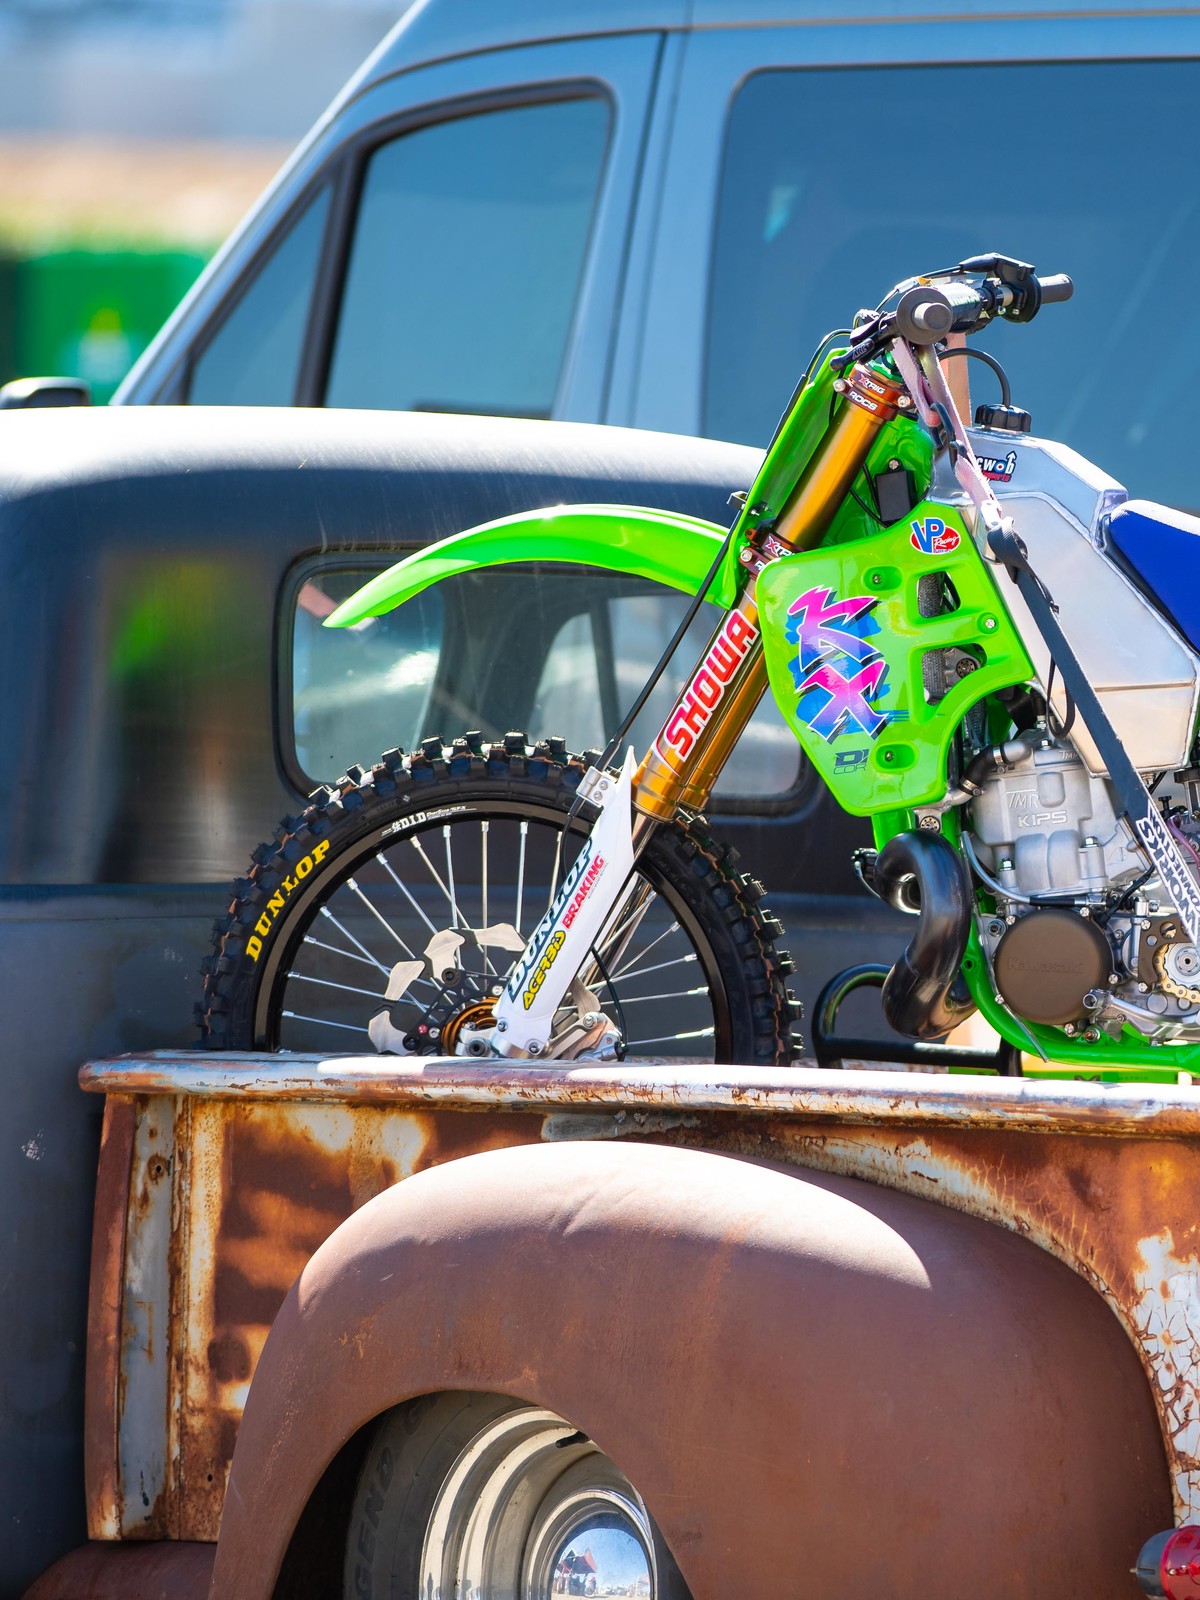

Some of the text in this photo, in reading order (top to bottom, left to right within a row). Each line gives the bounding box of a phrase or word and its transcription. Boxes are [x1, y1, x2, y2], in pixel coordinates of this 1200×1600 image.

[849, 391, 878, 411] ROCS
[859, 374, 886, 394] XTRIG
[765, 535, 795, 558] XTR
[911, 518, 945, 553] VP
[664, 608, 760, 763] SHOWA
[786, 584, 891, 744] KX
[1018, 810, 1068, 828] KIPS
[245, 840, 331, 963] DUNLOP
[507, 836, 593, 1004] DUNLOP
[562, 854, 605, 930] BRAKING
[1139, 820, 1197, 933] WORKS
[354, 1446, 394, 1600] GEND
